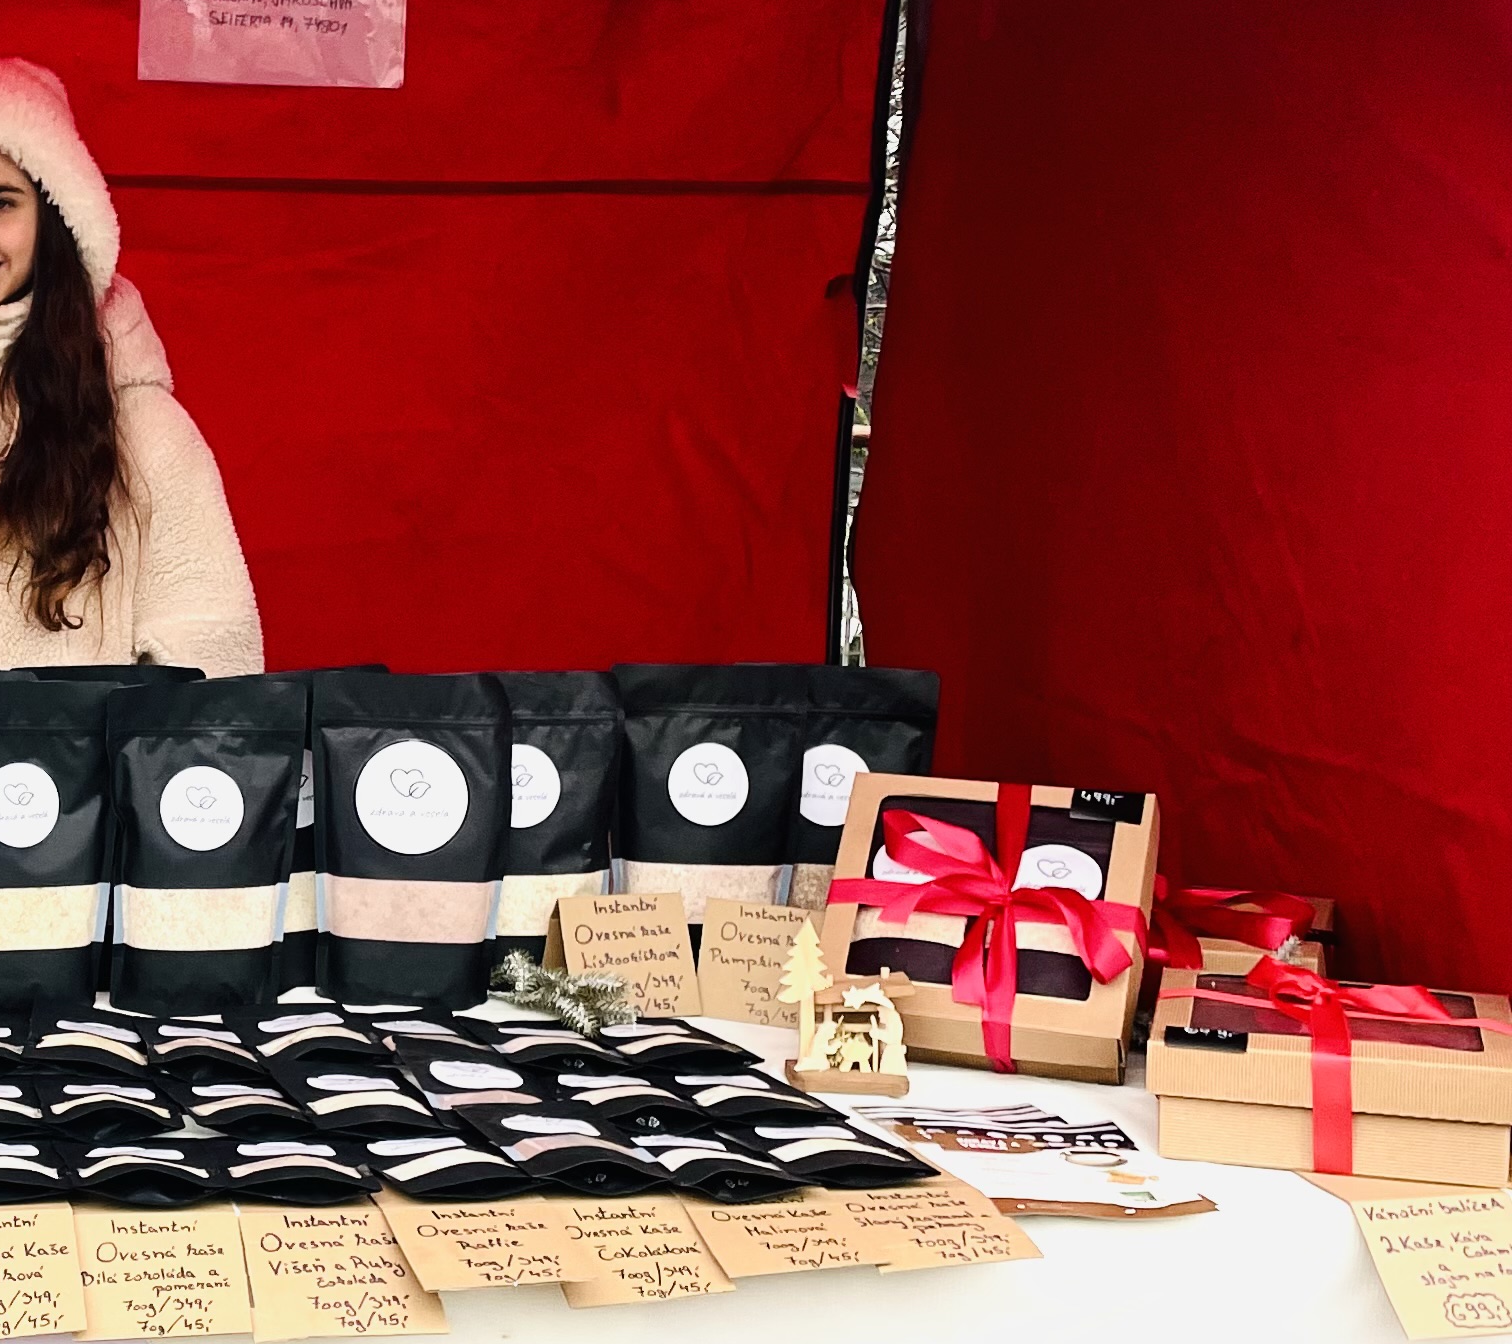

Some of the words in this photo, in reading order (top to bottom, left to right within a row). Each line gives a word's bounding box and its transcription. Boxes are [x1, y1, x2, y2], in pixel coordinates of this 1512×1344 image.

[593, 897, 658, 915] Instantní
[575, 924, 636, 945] Ovesná
[721, 921, 781, 945] Ovesná
[283, 1214, 370, 1229] Instantní
[431, 1208, 515, 1220] Instantní
[573, 1205, 657, 1222] Instantní
[712, 1210, 786, 1222] Ovesná
[110, 1219, 198, 1234] Instantní
[417, 1224, 499, 1238] Ovesná
[260, 1232, 345, 1253] Ovesná
[96, 1241, 177, 1263] Ovesná
[208, 1269, 220, 1277] a
[334, 1263, 346, 1271] a
[349, 1255, 406, 1278] Ruby
[1438, 1264, 1451, 1272] a
